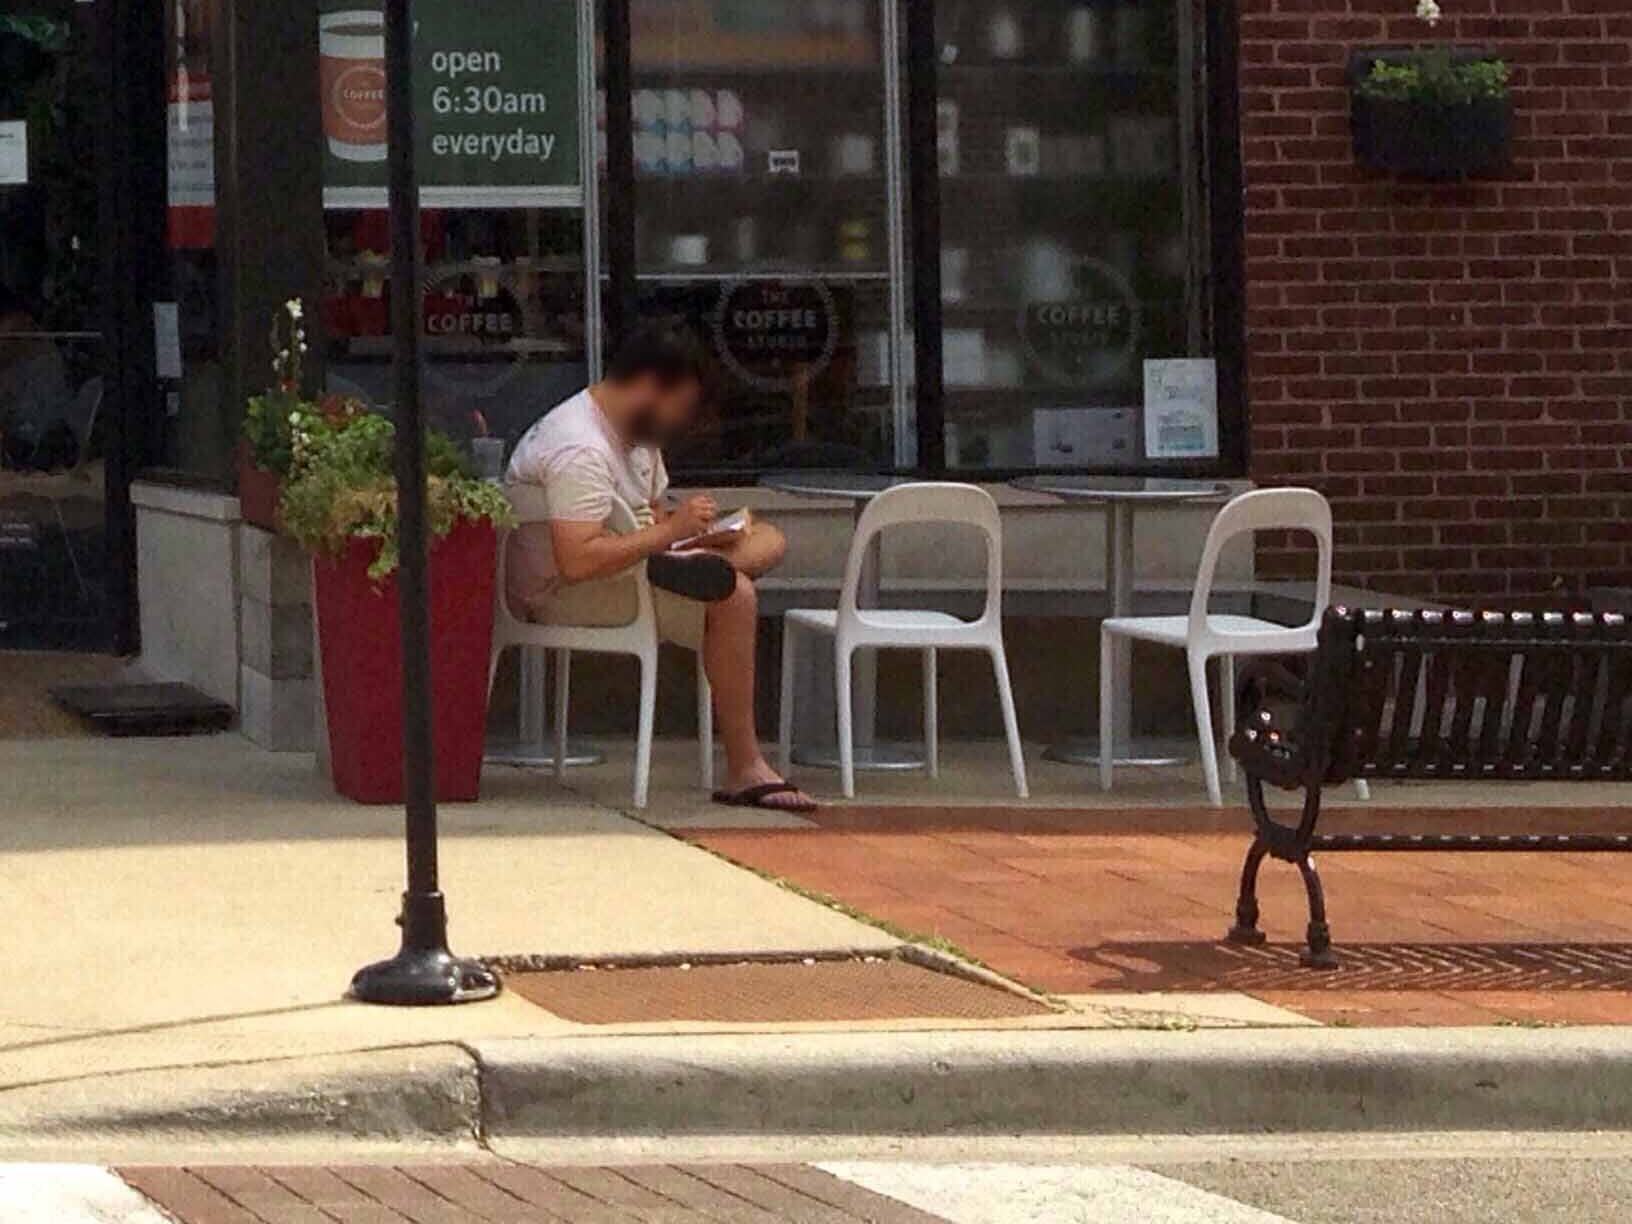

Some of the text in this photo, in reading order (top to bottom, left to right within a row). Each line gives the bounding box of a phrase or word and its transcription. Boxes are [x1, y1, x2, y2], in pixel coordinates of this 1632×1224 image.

[431, 50, 501, 78] open
[432, 86, 546, 114] 6:30am
[432, 128, 556, 162] everyday
[428, 312, 513, 333] COFFEE
[733, 309, 817, 329] COFFEE
